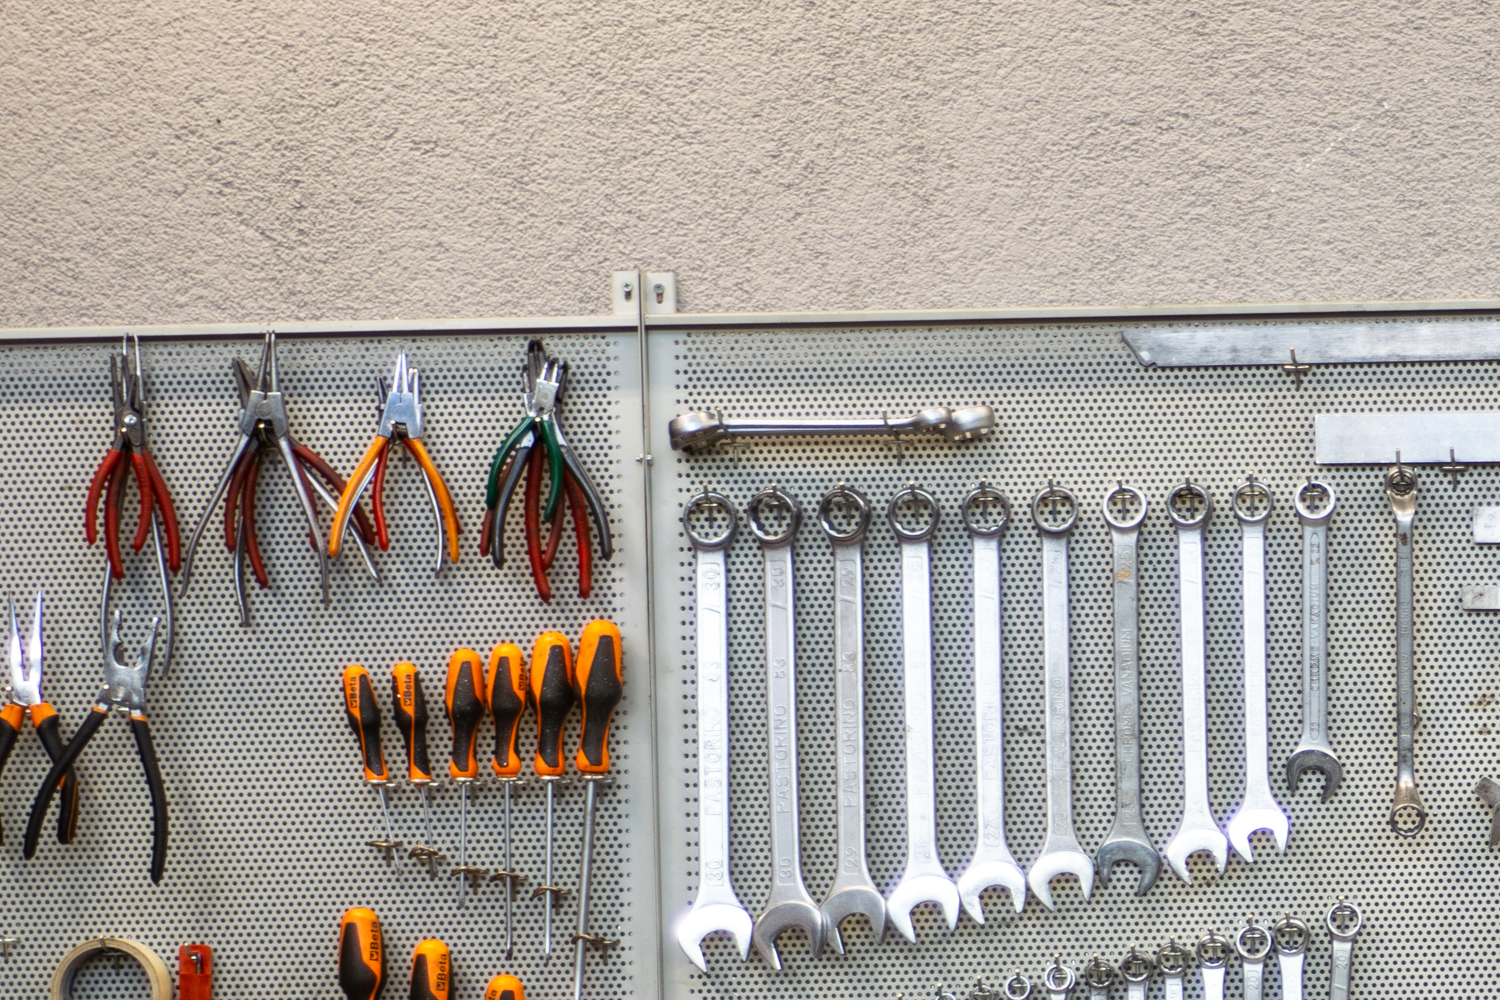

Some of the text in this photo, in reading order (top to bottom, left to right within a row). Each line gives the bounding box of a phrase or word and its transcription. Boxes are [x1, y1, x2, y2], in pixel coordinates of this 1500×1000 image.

[404, 674, 413, 698] Beta
[1118, 628, 1133, 697] VANADIUM
[349, 677, 358, 700] Beta
[701, 708, 722, 816] PASTORINO
[773, 705, 791, 815] PASTORINO
[842, 699, 860, 809] PASTORINO
[370, 921, 379, 950] Beta
[436, 953, 447, 981] Beta
